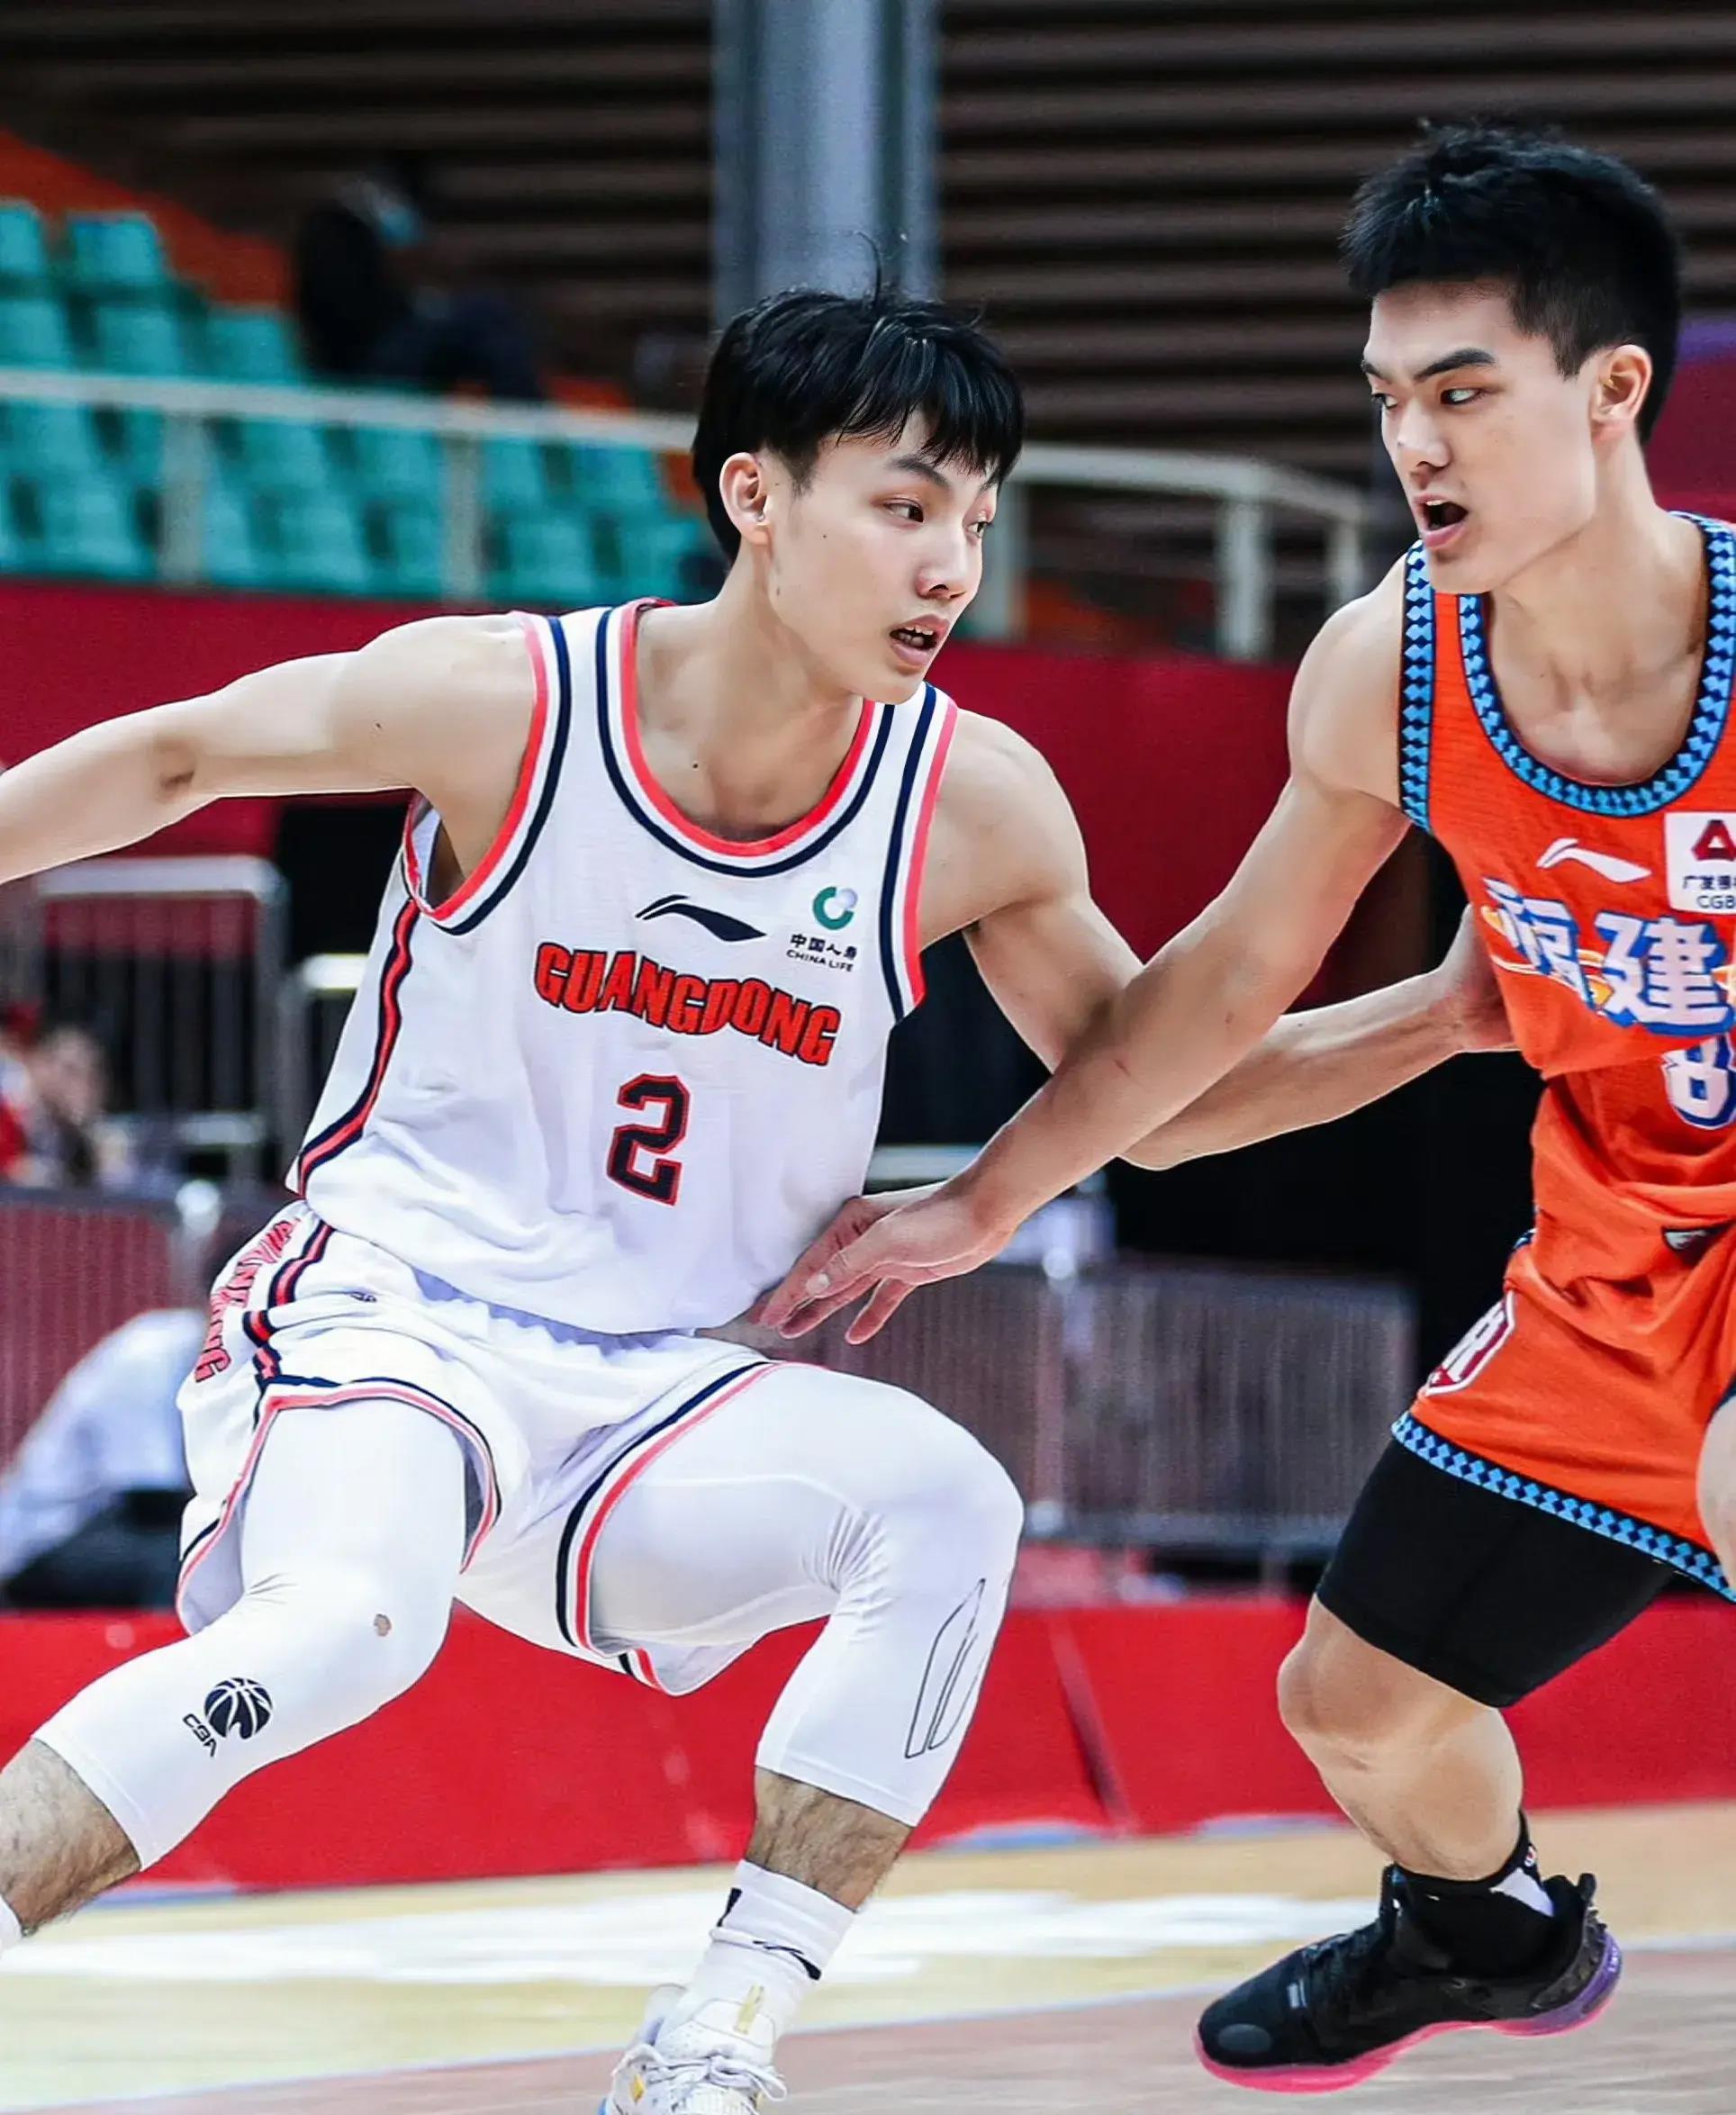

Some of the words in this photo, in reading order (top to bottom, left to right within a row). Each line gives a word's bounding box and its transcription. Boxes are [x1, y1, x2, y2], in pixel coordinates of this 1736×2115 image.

[1683, 875, 1736, 890] 广发银
[1696, 895, 1736, 909] CGB
[786, 949, 827, 965] CHINA
[828, 960, 854, 972] LIFE
[534, 942, 841, 1066] GUANGDONG
[607, 1072, 691, 1207] 2
[182, 1713, 217, 1758] CBA
